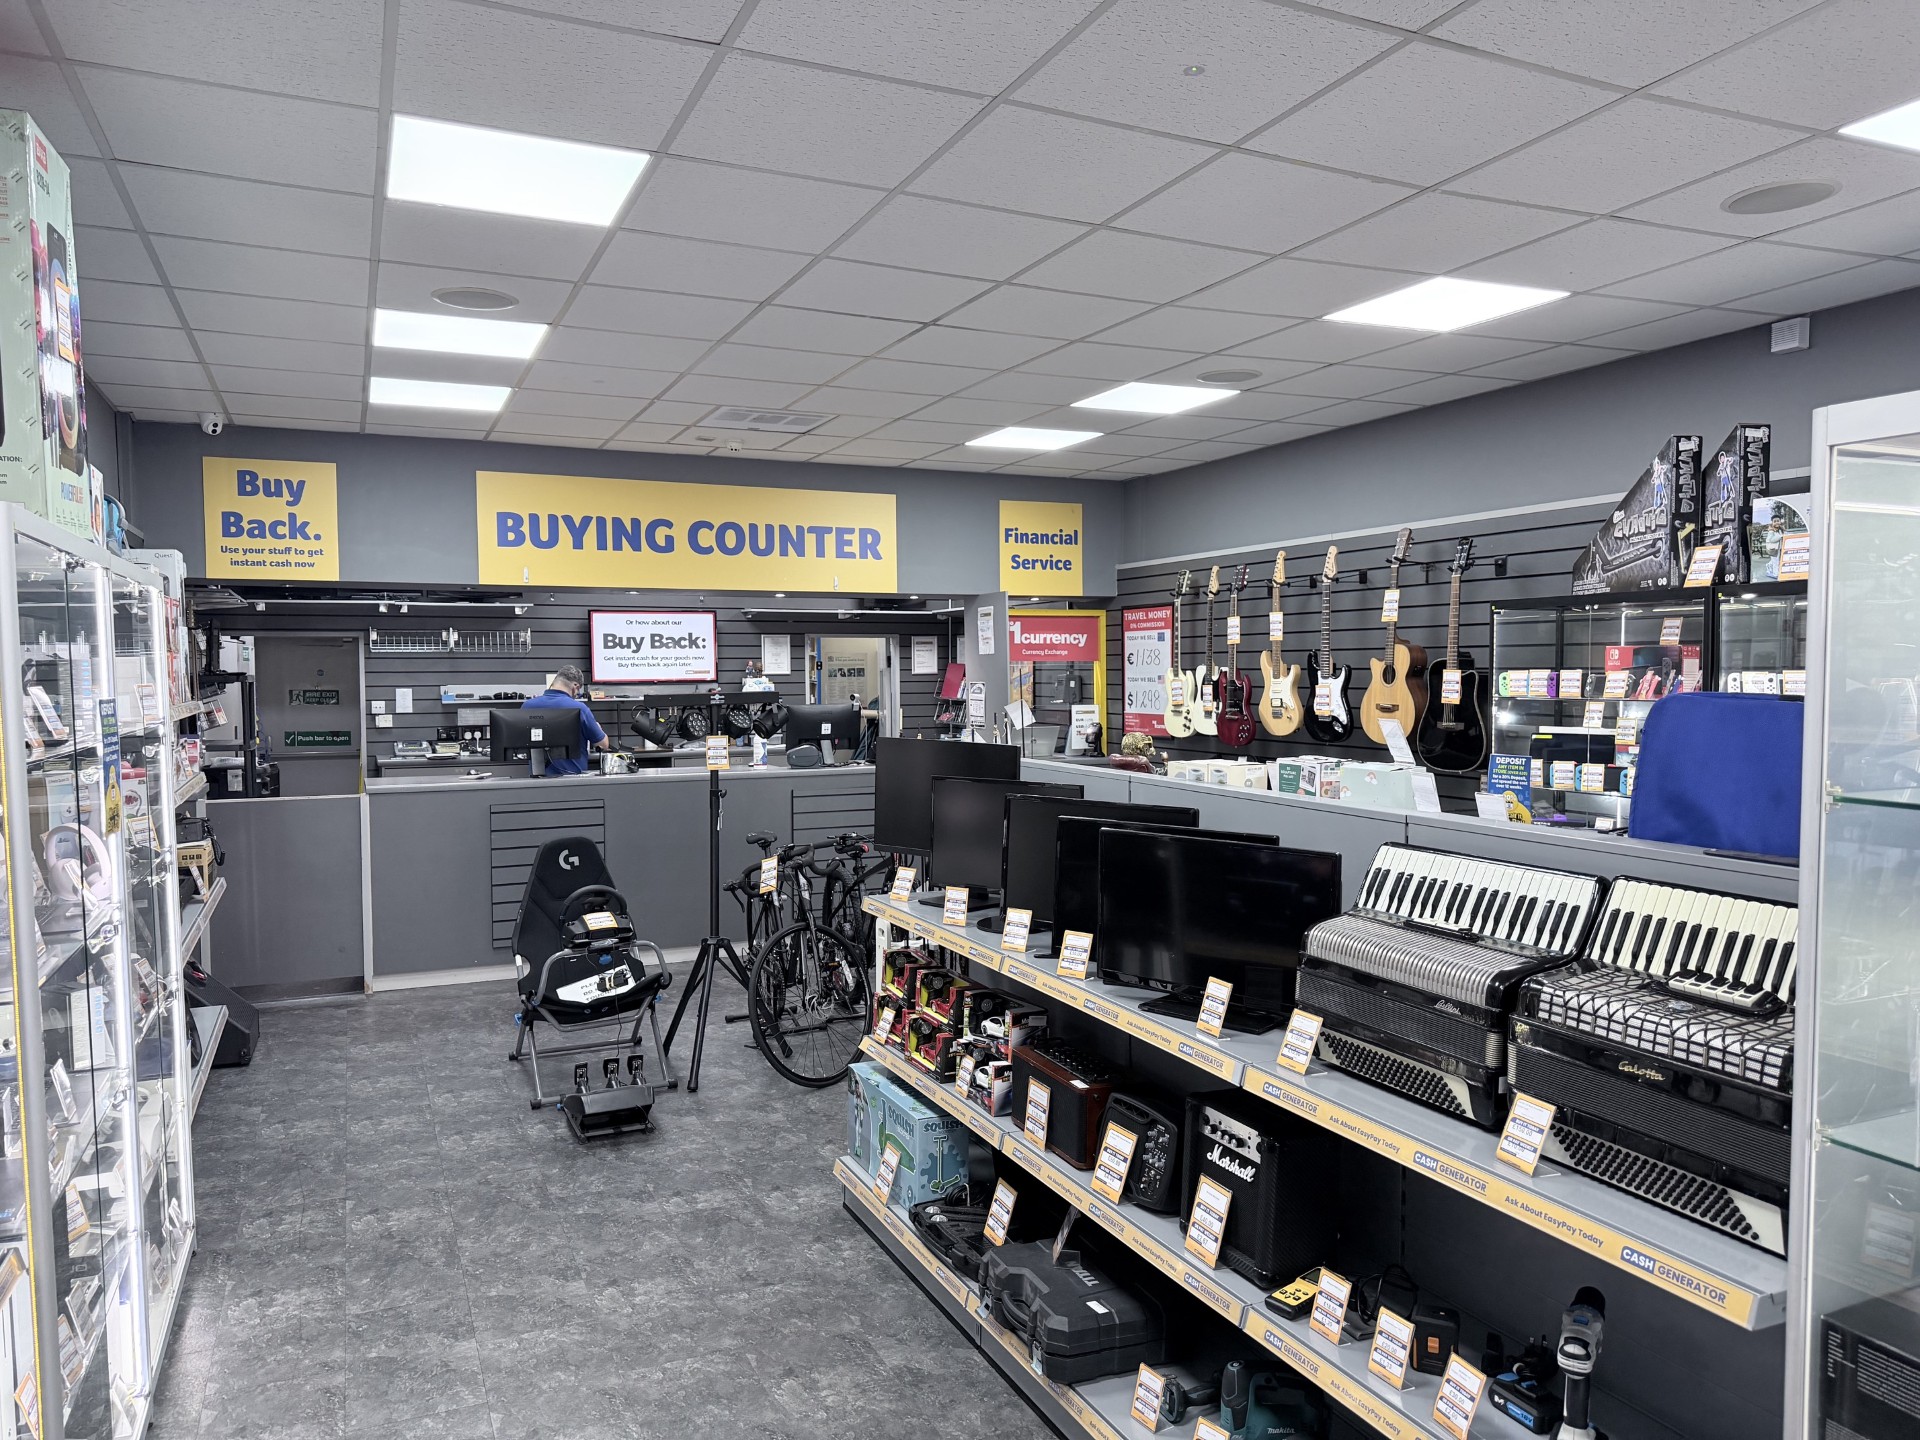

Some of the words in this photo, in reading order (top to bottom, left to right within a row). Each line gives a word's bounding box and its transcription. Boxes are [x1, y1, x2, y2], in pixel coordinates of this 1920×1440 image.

[237, 469, 306, 507] Buy
[221, 511, 322, 541] Back.
[496, 511, 675, 553] BUYING
[687, 520, 883, 561] COUNTER
[1004, 528, 1078, 546] Financial
[220, 546, 239, 554] Use
[242, 547, 266, 556] your
[268, 546, 292, 555] stuff
[308, 548, 324, 558] get
[230, 558, 267, 566] instant
[269, 559, 292, 568] cash
[1010, 554, 1072, 571] Service
[1124, 612, 1146, 621] TRAVEL
[1149, 610, 1170, 618] MONEY
[603, 633, 645, 654] Buy
[650, 632, 706, 649] Back:
[1496, 757, 1526, 765] DEPOSIT
[1096, 1003, 1119, 1020] GENERATOR
[1180, 1043, 1193, 1055] CASH
[1194, 1051, 1224, 1069] GENERATOR
[1264, 1083, 1280, 1097] CASH
[1282, 1092, 1318, 1114] GENERATOR
[888, 1104, 914, 1138] SQUISH
[1329, 1115, 1340, 1124] Ask
[1340, 1118, 1357, 1132] About
[1357, 1126, 1382, 1145] EasyPay
[1382, 1139, 1400, 1154] Today
[1207, 1144, 1256, 1182] Marshall
[1415, 1152, 1437, 1170] CASH
[1439, 1164, 1486, 1192] GENERATOR
[1101, 1211, 1125, 1234] GENERATOR
[1505, 1195, 1518, 1207] Ask
[1520, 1202, 1543, 1218] About
[1543, 1213, 1576, 1234] EasyPay
[1578, 1228, 1604, 1247] Today
[1139, 1240, 1150, 1254] About
[1150, 1249, 1166, 1266] EasyPay
[1165, 1259, 1177, 1273] Today
[1622, 1249, 1654, 1270] CASH
[1658, 1265, 1726, 1304] GENERATOR
[1184, 1274, 1199, 1290] CASH
[1200, 1284, 1231, 1311] GENERATOR
[1265, 1332, 1282, 1349] CASH
[1284, 1345, 1319, 1375] GENERATOR
[1061, 1392, 1083, 1416] GENERATOR
[1330, 1380, 1341, 1390] Ask
[1342, 1386, 1357, 1402] About
[1358, 1400, 1382, 1422] EasyPay
[1382, 1414, 1401, 1435] Today
